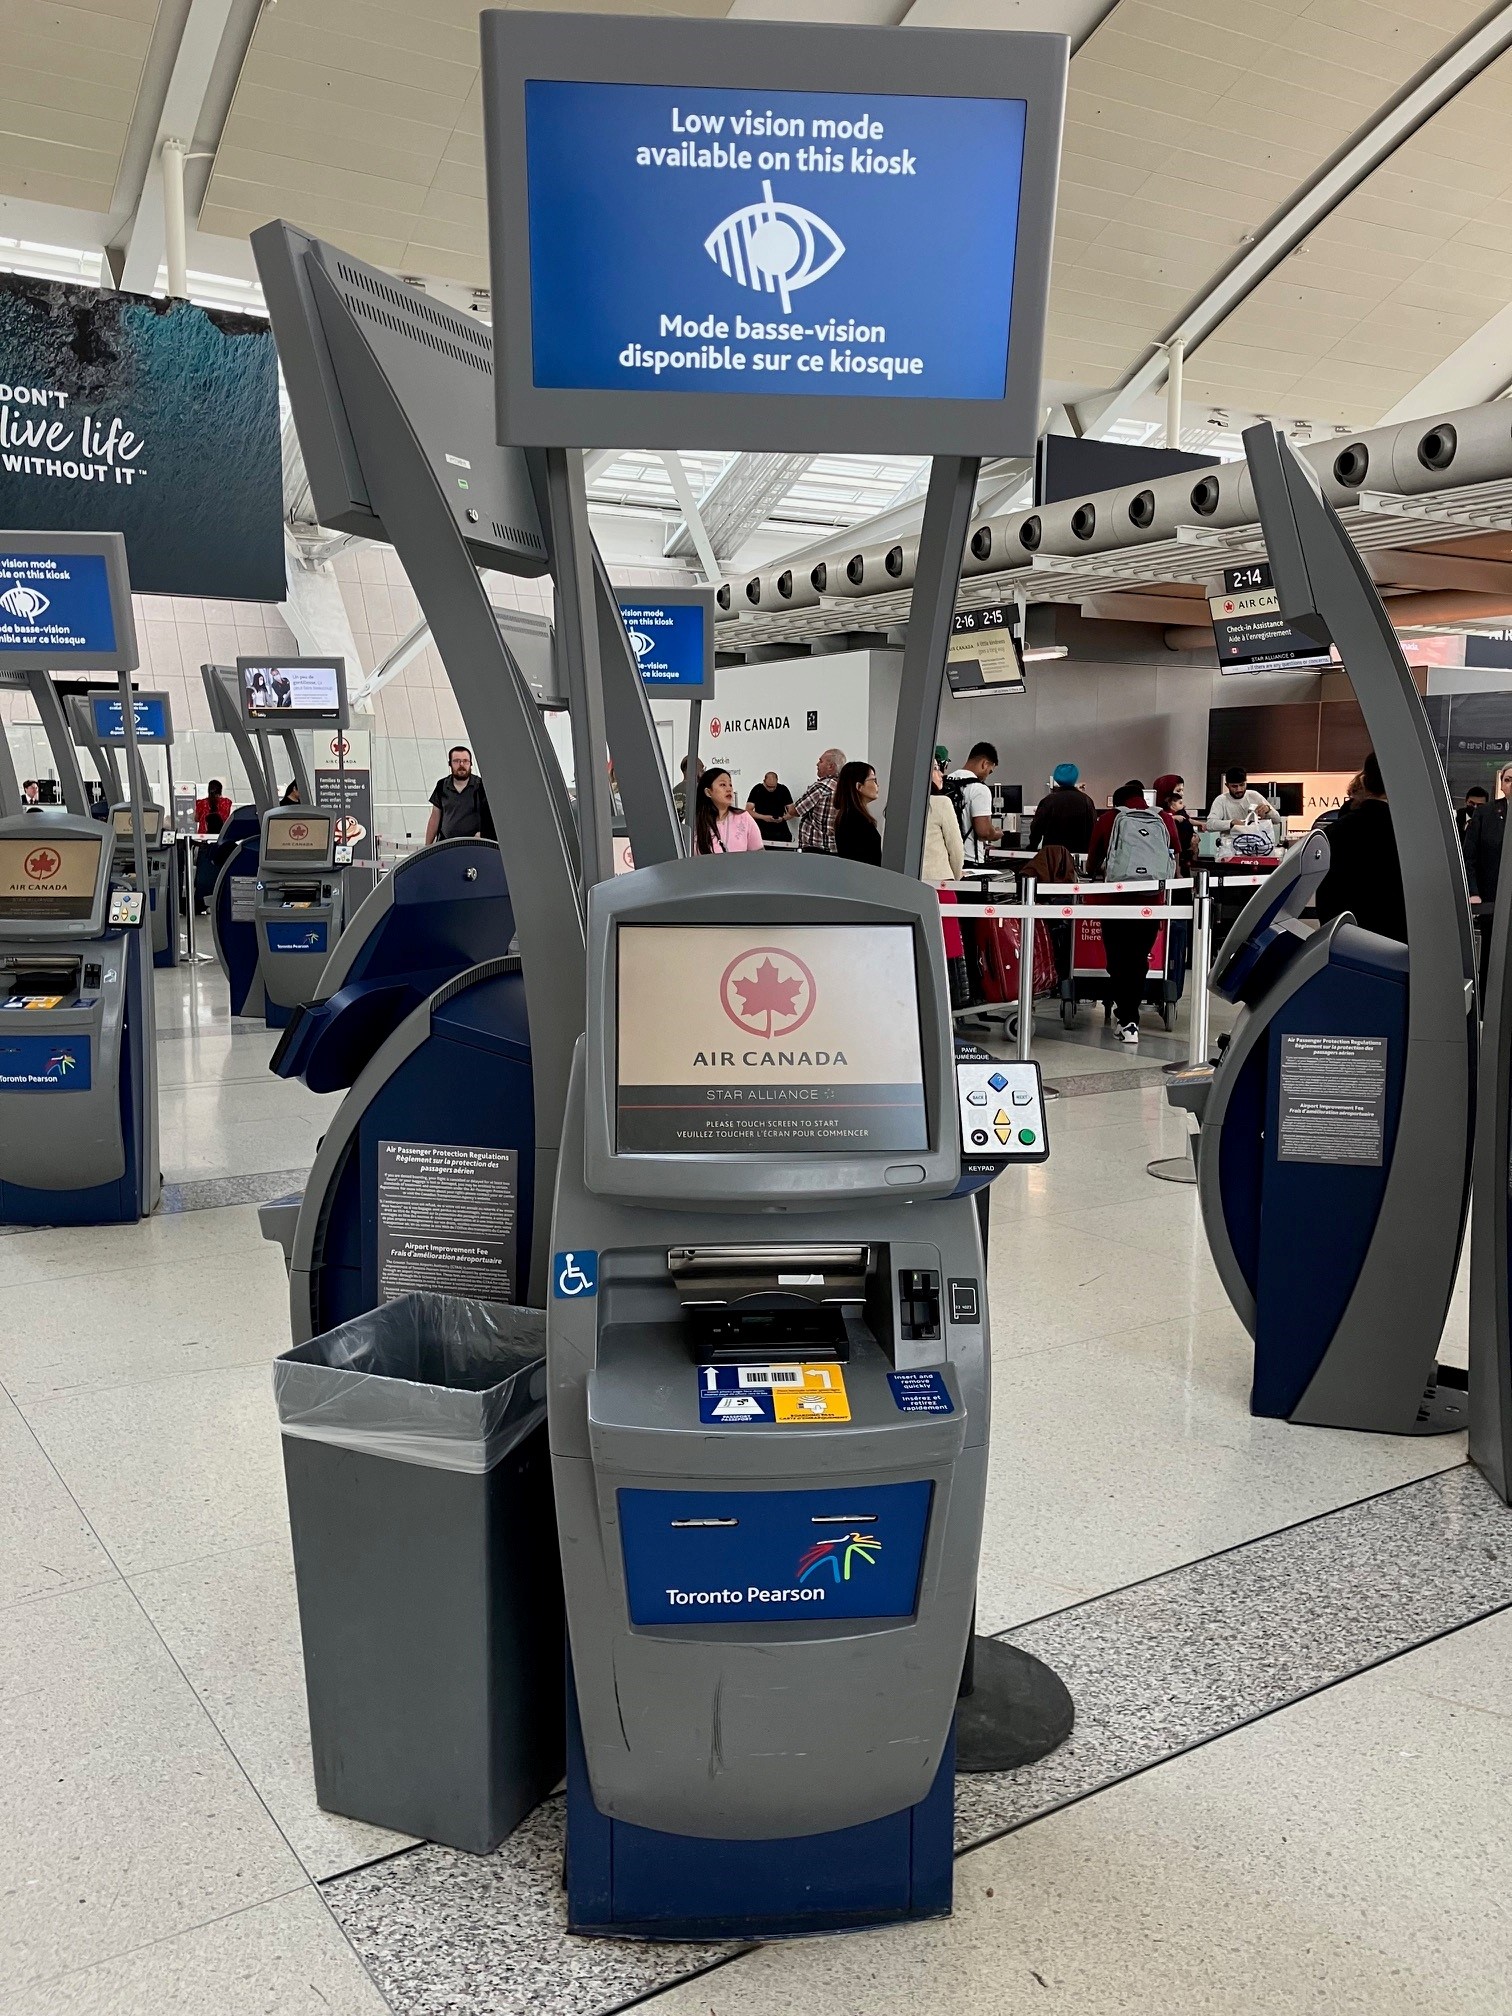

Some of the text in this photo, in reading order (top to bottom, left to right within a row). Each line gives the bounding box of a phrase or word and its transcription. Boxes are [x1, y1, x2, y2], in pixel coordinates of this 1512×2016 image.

[671, 107, 884, 140] Low vision mode
[636, 142, 916, 176] available on this kiosk
[660, 314, 886, 344] Mode basse-vision
[619, 344, 924, 382] disponible sur ce kiosque
[0, 384, 68, 409] DON'T
[1, 405, 145, 465] live life
[2, 454, 107, 482] WITHOUT
[1, 559, 57, 569] vision mode
[13, 571, 26, 579] on
[27, 570, 45, 580] this
[48, 570, 71, 580] kiosk
[1233, 569, 1262, 588] 2-14
[1238, 600, 1256, 609] AIR
[639, 618, 653, 626] this
[654, 617, 673, 626] kiosk
[1227, 620, 1284, 633] Check-in Assistance
[14, 624, 70, 634] basse-vision
[22, 636, 37, 644] sur
[39, 636, 49, 644] ce
[50, 635, 86, 646] kiosque
[1229, 634, 1241, 643] Aide
[652, 670, 680, 679] kiosque
[724, 716, 790, 733] AIR CANADA
[711, 757, 730, 765] Check-in
[693, 1051, 848, 1067] AIR CANADA
[28, 1075, 58, 1083] Pearson
[707, 1089, 819, 1100] STAR ALLIANCE
[706, 1120, 734, 1128] PLEASE
[736, 1120, 766, 1128] TOUCH
[767, 1120, 799, 1128] SCREEN
[813, 1119, 839, 1128] START
[676, 1128, 869, 1139] VEUILLEZ TOUCHER L'ÉCRAN POUR COMMENCER
[398, 1147, 431, 1156] Passenger
[432, 1149, 468, 1158] Protection
[469, 1152, 509, 1161] Regulations
[396, 1154, 432, 1164] Règlement
[451, 1159, 487, 1168] protection
[420, 1165, 475, 1175] passagers aérien
[405, 1242, 429, 1251] Airport
[430, 1243, 475, 1255] Improvement
[407, 1250, 455, 1261] d'amélioration
[456, 1255, 502, 1265] aéroportuaire
[666, 1587, 825, 1605] Toronto Pearson
